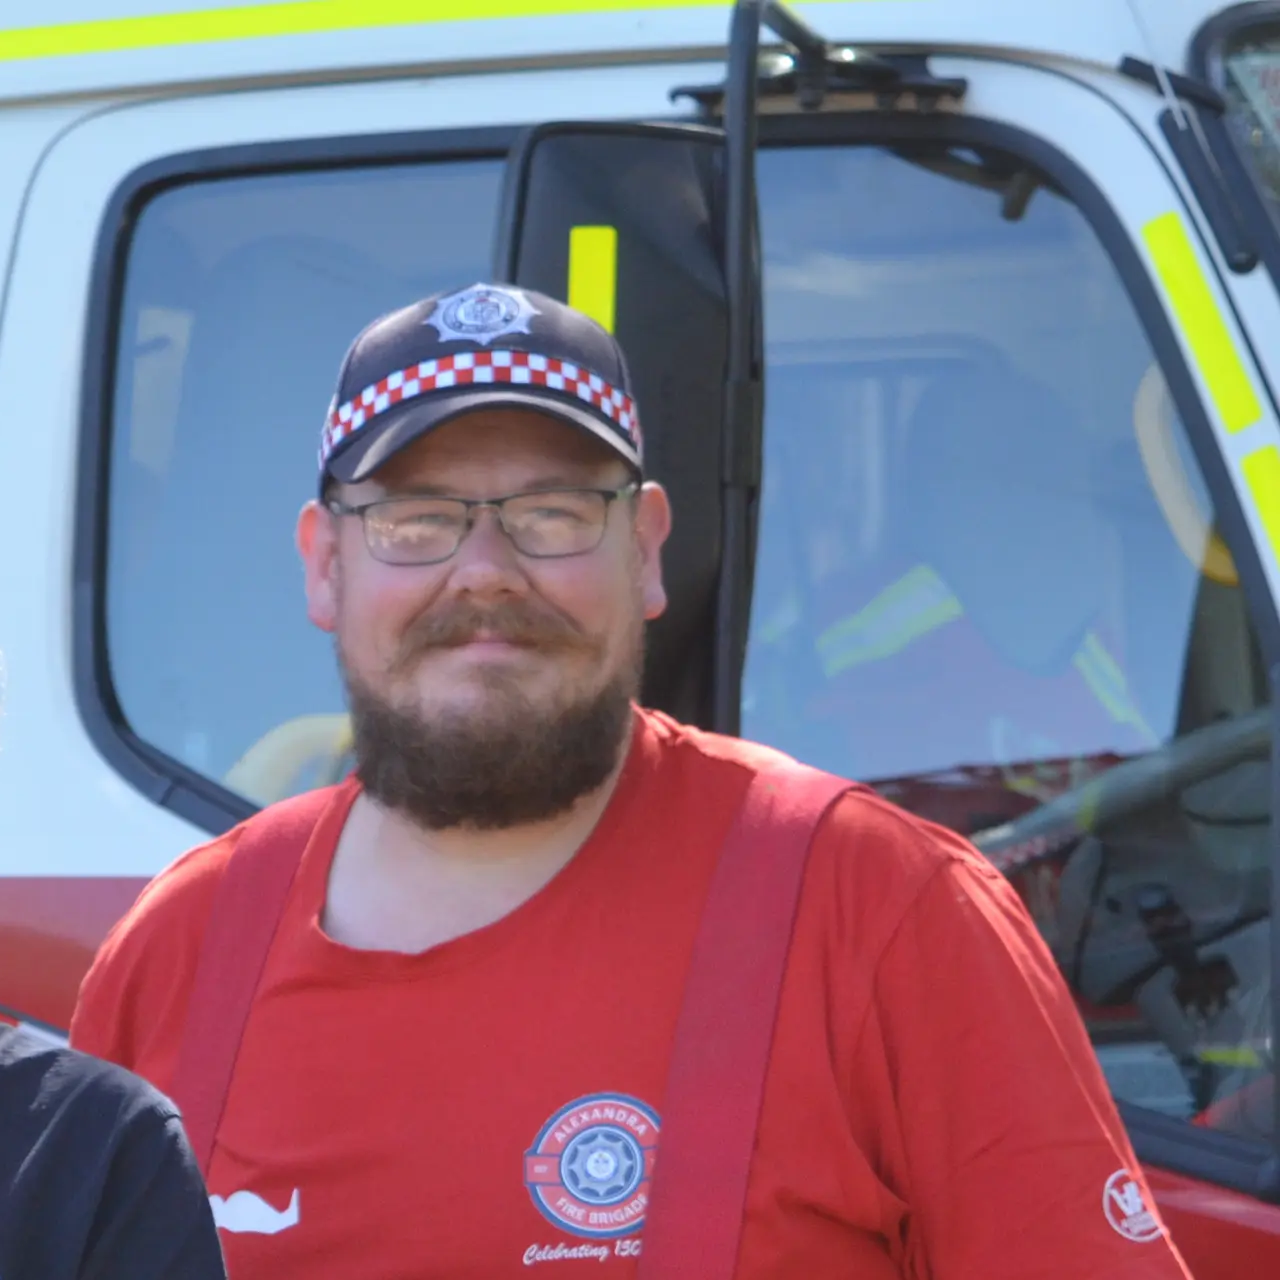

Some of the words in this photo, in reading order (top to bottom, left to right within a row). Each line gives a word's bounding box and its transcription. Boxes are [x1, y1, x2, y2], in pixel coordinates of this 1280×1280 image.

[554, 1106, 648, 1144] ALEXANDRA
[555, 1196, 585, 1224] FIRE
[522, 1241, 610, 1266] Celebrating
